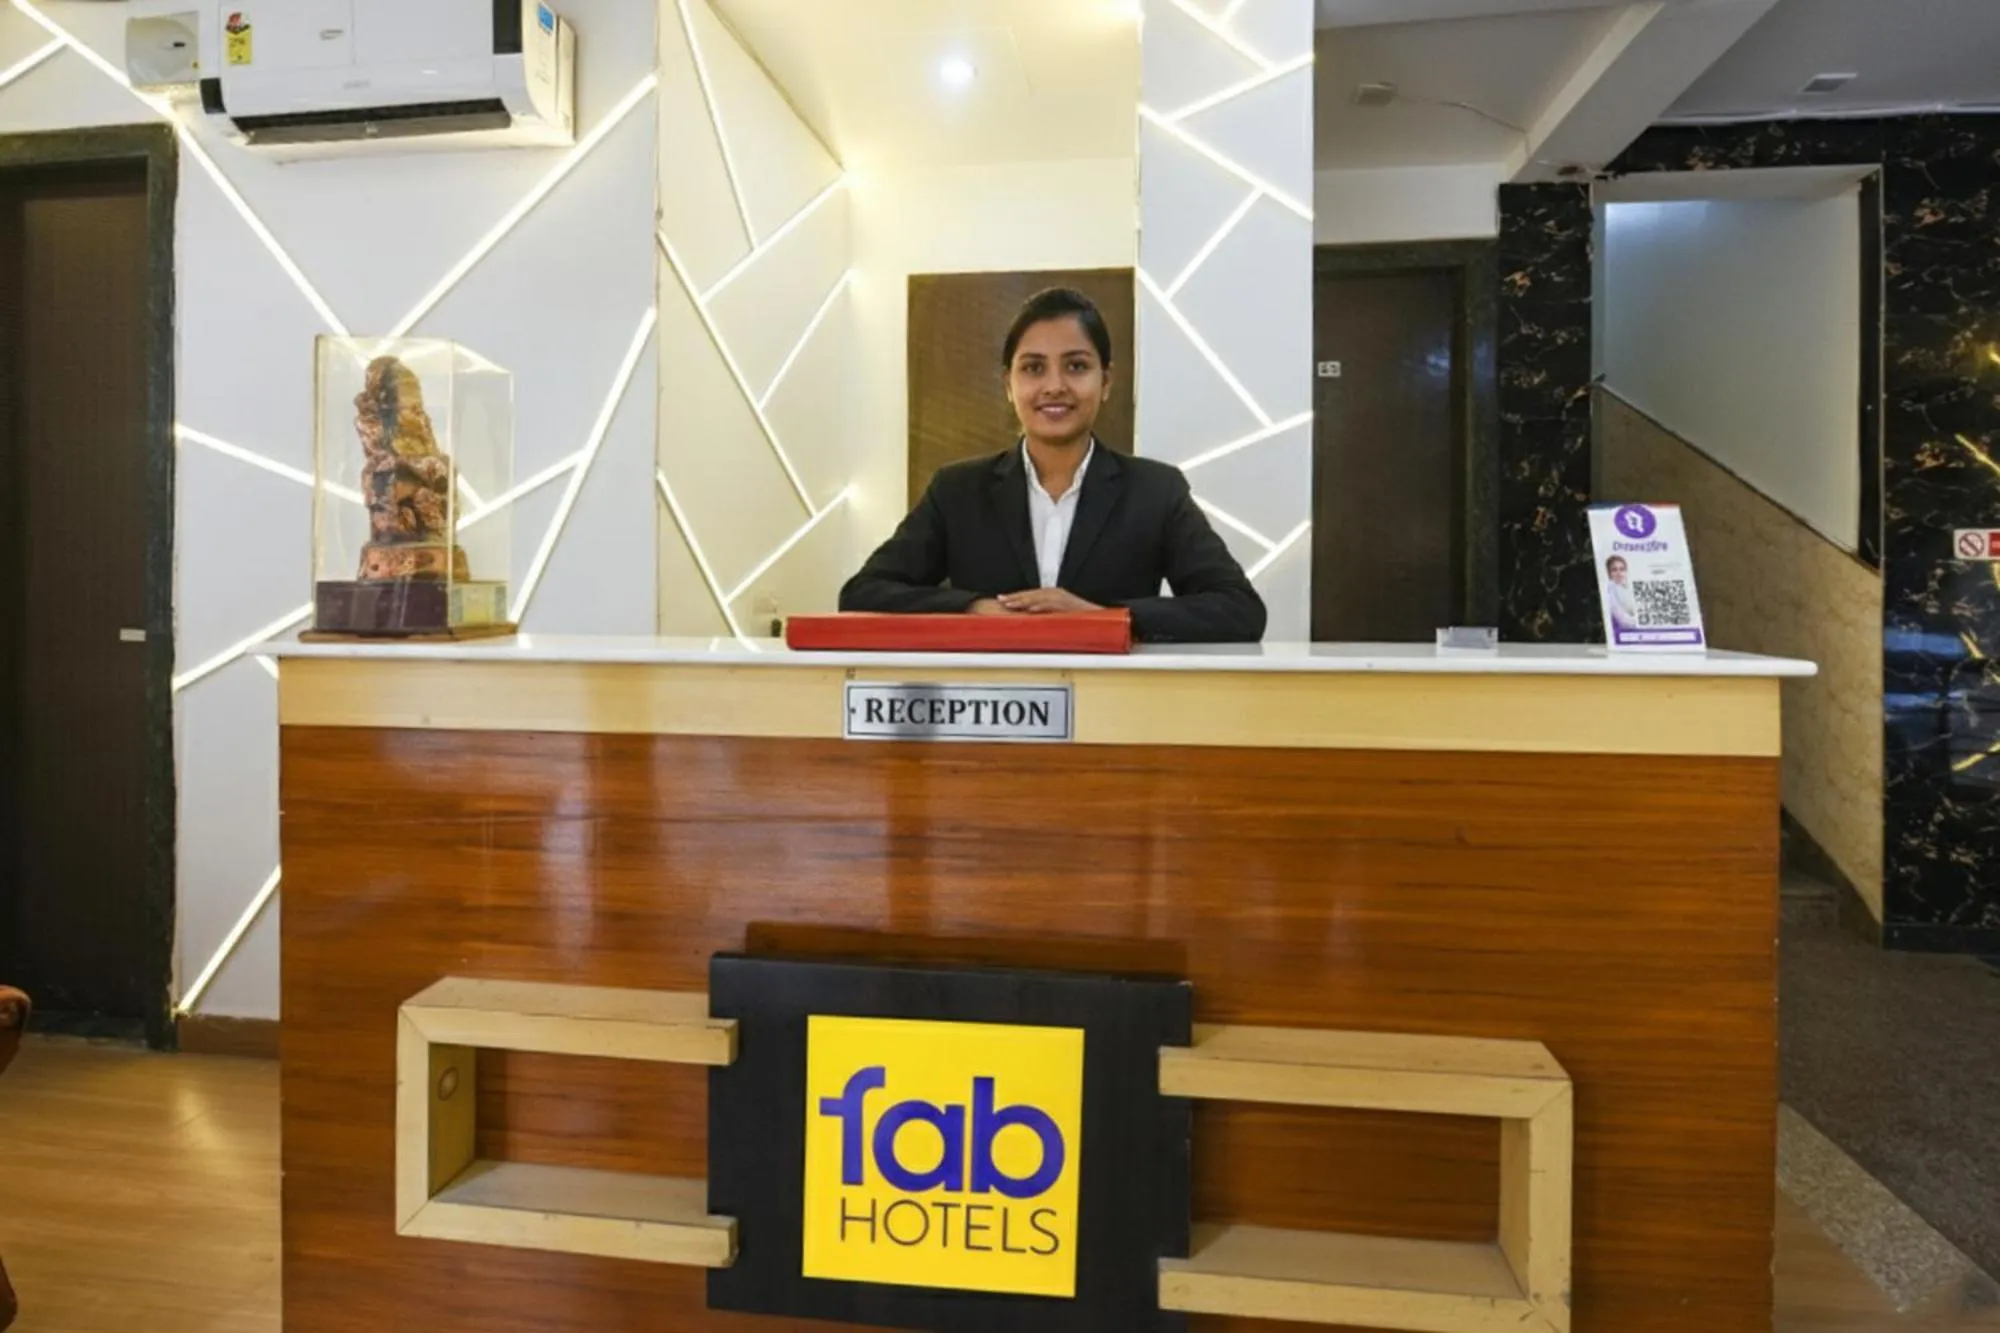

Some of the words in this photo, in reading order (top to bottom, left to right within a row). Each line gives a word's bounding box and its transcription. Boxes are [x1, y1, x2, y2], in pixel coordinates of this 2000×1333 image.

[864, 698, 1049, 726] RECEPTION
[819, 1065, 1066, 1200] fab
[840, 1197, 1060, 1256] HOTELS
